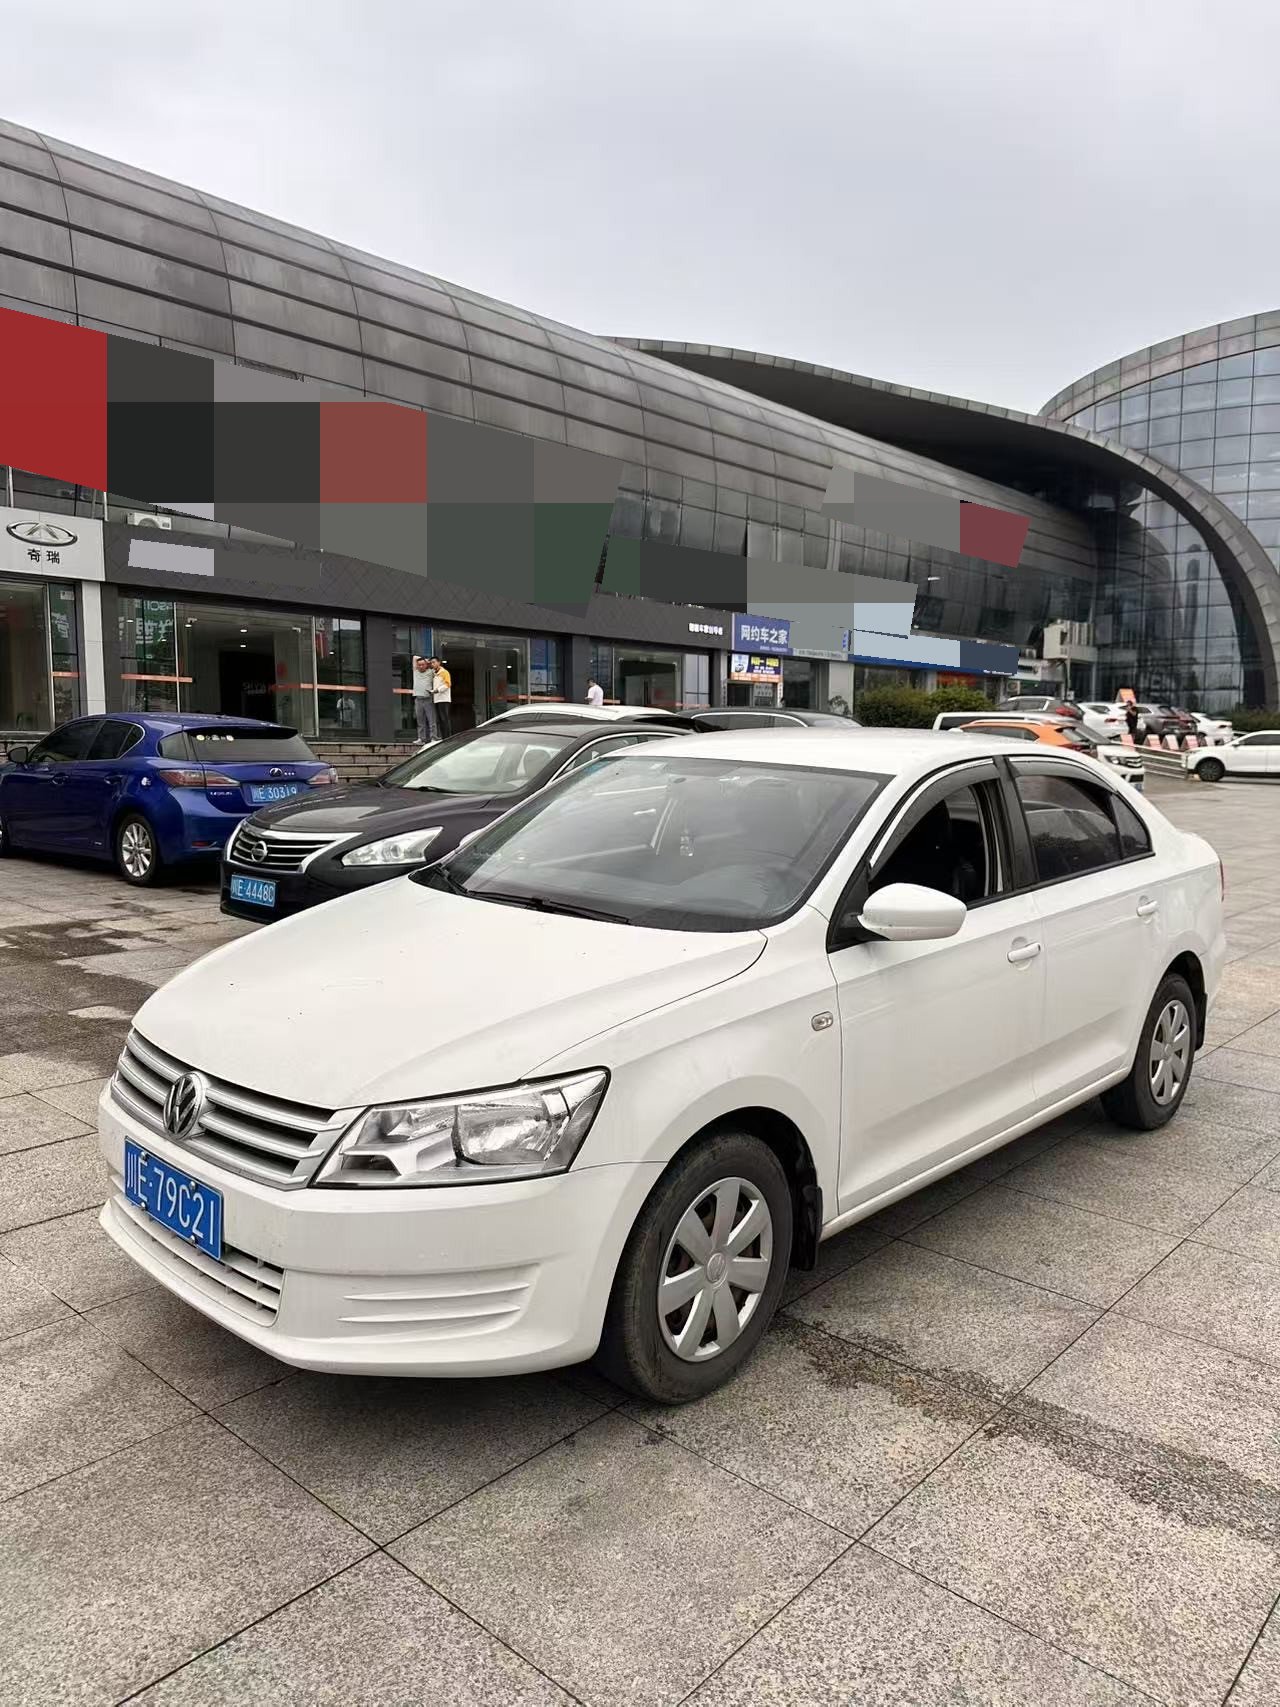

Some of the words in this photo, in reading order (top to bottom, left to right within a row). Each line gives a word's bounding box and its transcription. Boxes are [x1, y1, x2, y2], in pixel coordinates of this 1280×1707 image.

[27, 548, 60, 564] 奇瑞
[740, 624, 788, 645] 网约车之家
